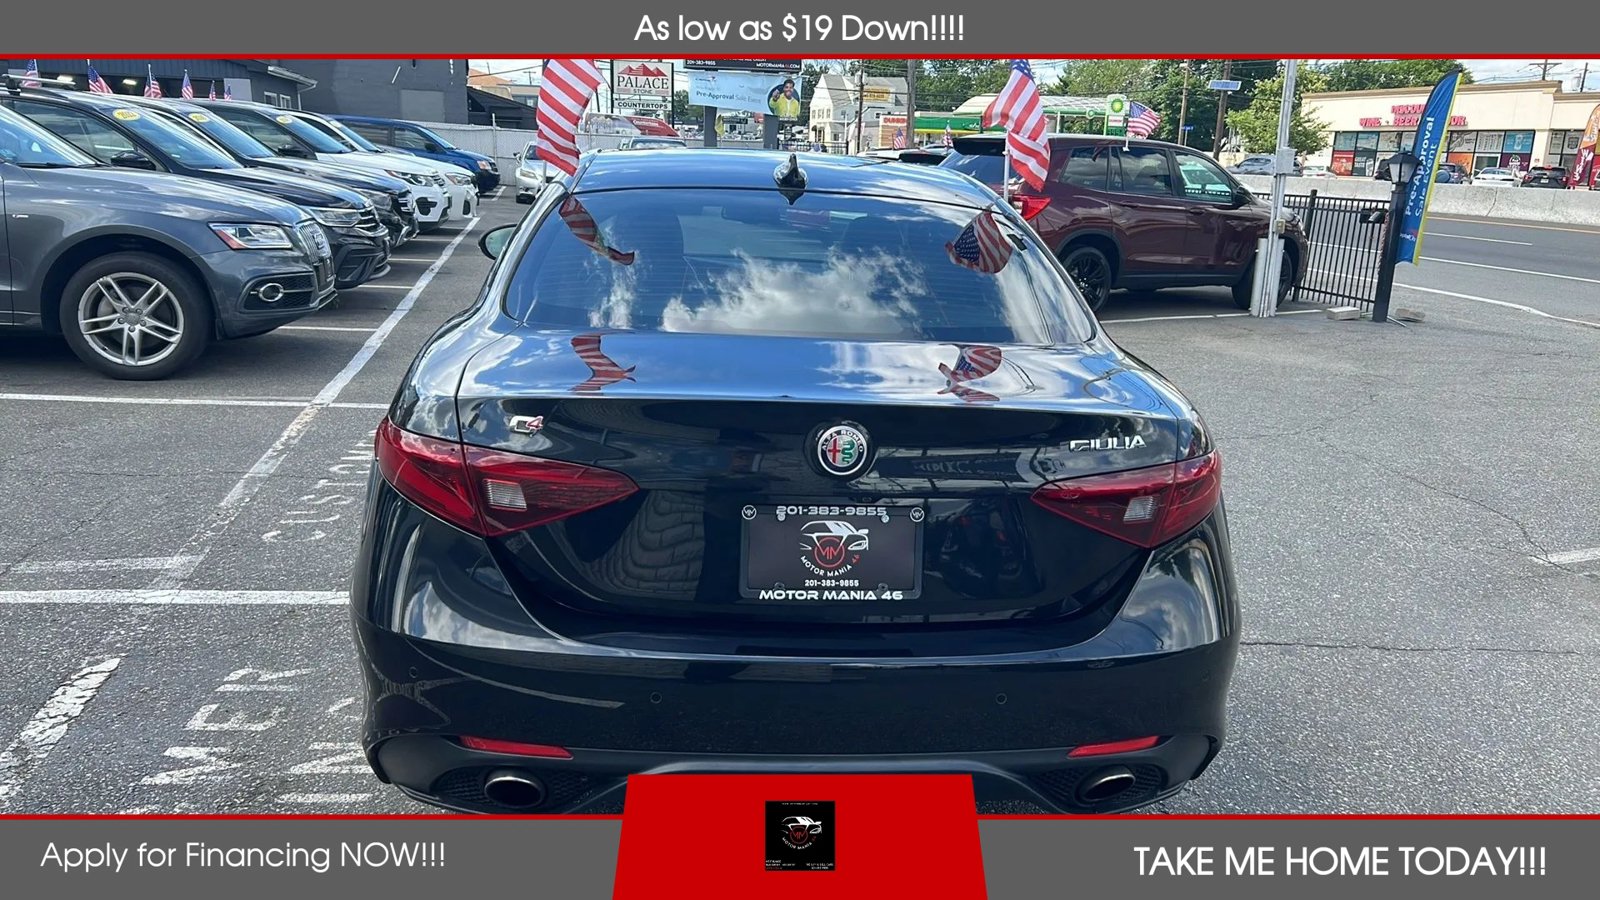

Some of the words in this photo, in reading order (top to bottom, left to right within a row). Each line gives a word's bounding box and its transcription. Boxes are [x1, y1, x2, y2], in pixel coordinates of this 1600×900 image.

[617, 75, 669, 90] PALACE
[695, 90, 736, 101] Pre-Approval
[617, 101, 669, 109] COUNTERTOPS
[1414, 186, 1427, 216] Sale
[1422, 143, 1438, 184] Event
[821, 431, 838, 451] ALFA
[840, 429, 864, 453] ROMEO
[1069, 435, 1148, 451] GIULIA
[775, 505, 888, 517] 201-383-9855
[800, 554, 825, 577] MOTOR
[826, 563, 853, 577] MANIA
[804, 579, 860, 588] 201-383-9855
[758, 589, 819, 600] MOTOR
[822, 590, 878, 600] MANIA
[880, 590, 904, 601] 46
